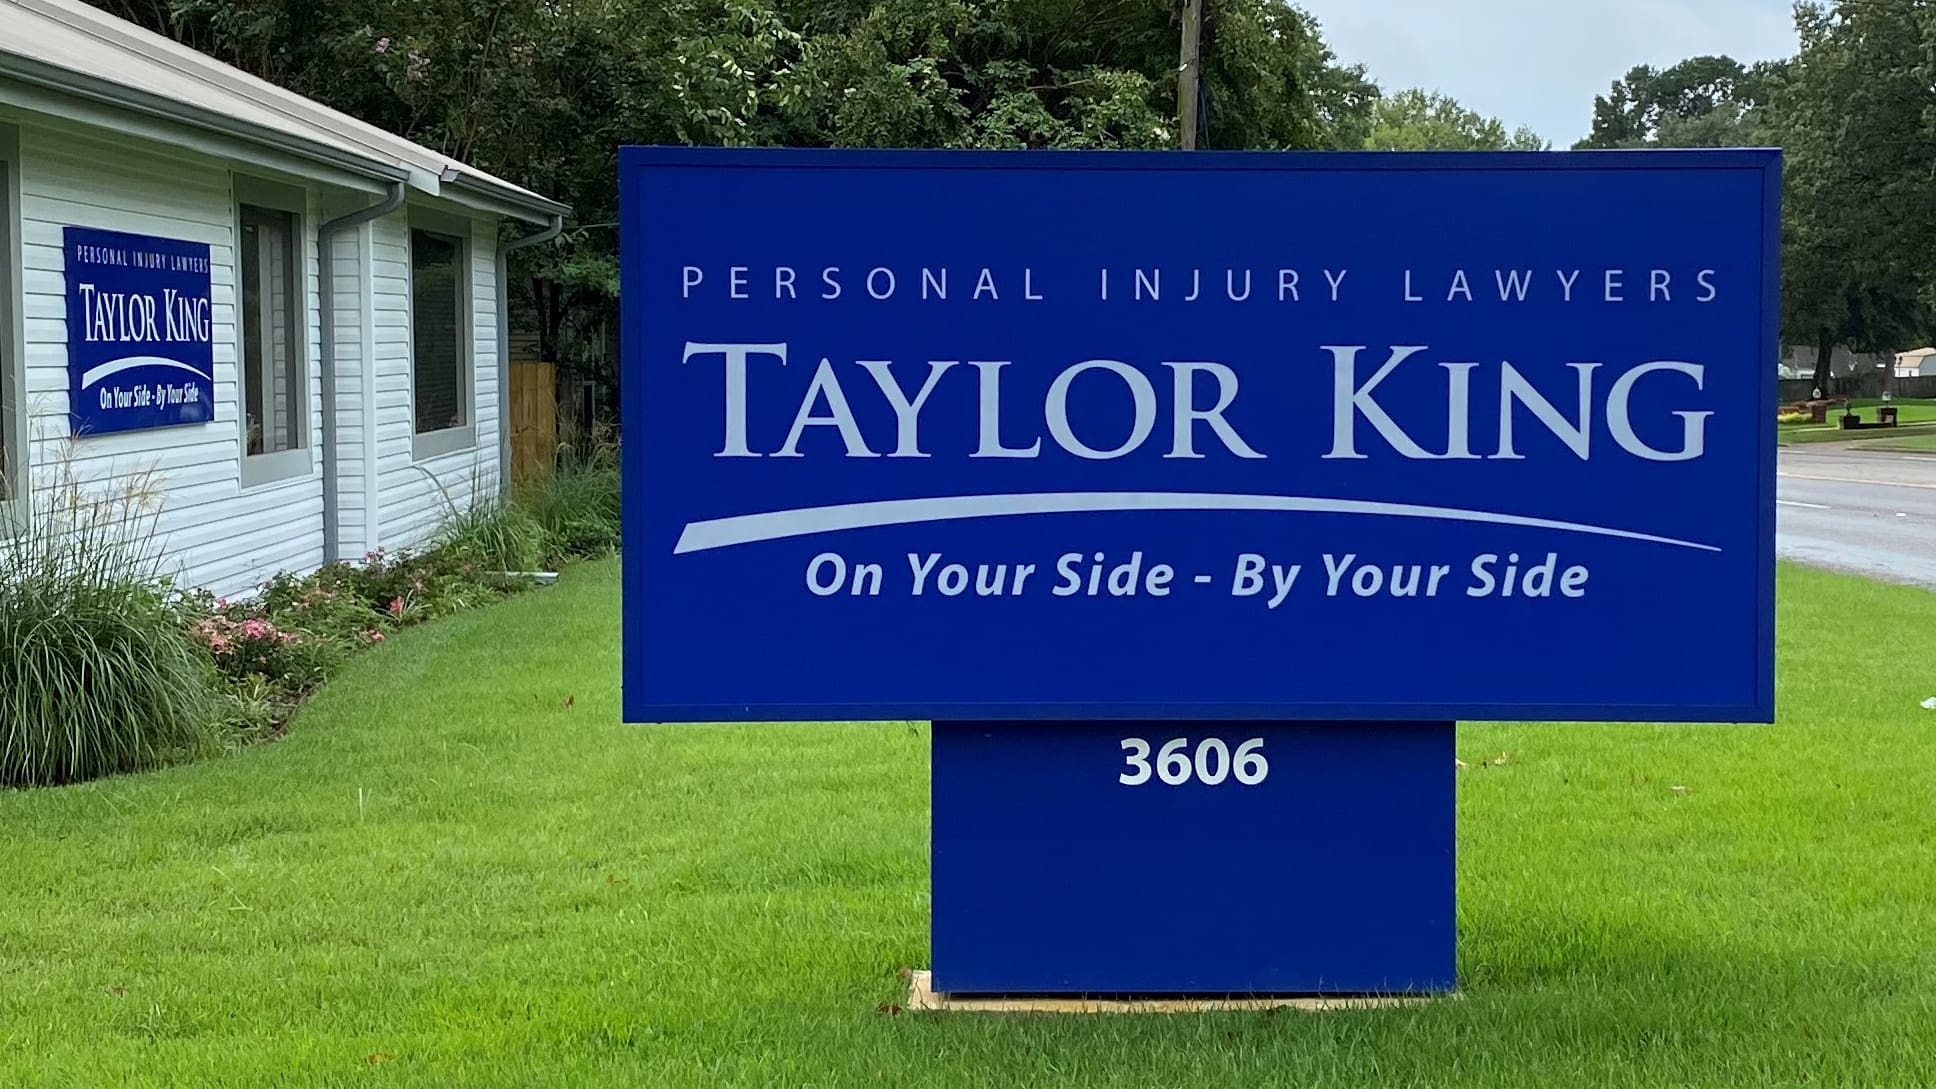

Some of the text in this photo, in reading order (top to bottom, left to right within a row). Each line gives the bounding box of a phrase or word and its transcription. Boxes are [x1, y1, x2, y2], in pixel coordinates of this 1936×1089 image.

[77, 244, 209, 274] PERSONAL INJURY LAWYERS
[684, 267, 1716, 302] PERSONAL INJURY LAWYERS
[79, 283, 209, 342] TAYLOR KING
[100, 386, 112, 410] On
[114, 386, 133, 409] Your
[133, 384, 151, 407] Side
[156, 384, 167, 410] By
[167, 383, 183, 404] Your
[183, 381, 199, 403] Side
[683, 342, 1714, 461] TAYLOR KING
[806, 552, 1589, 609] On Your Side - By Your Side
[1119, 738, 1269, 786] 3606
